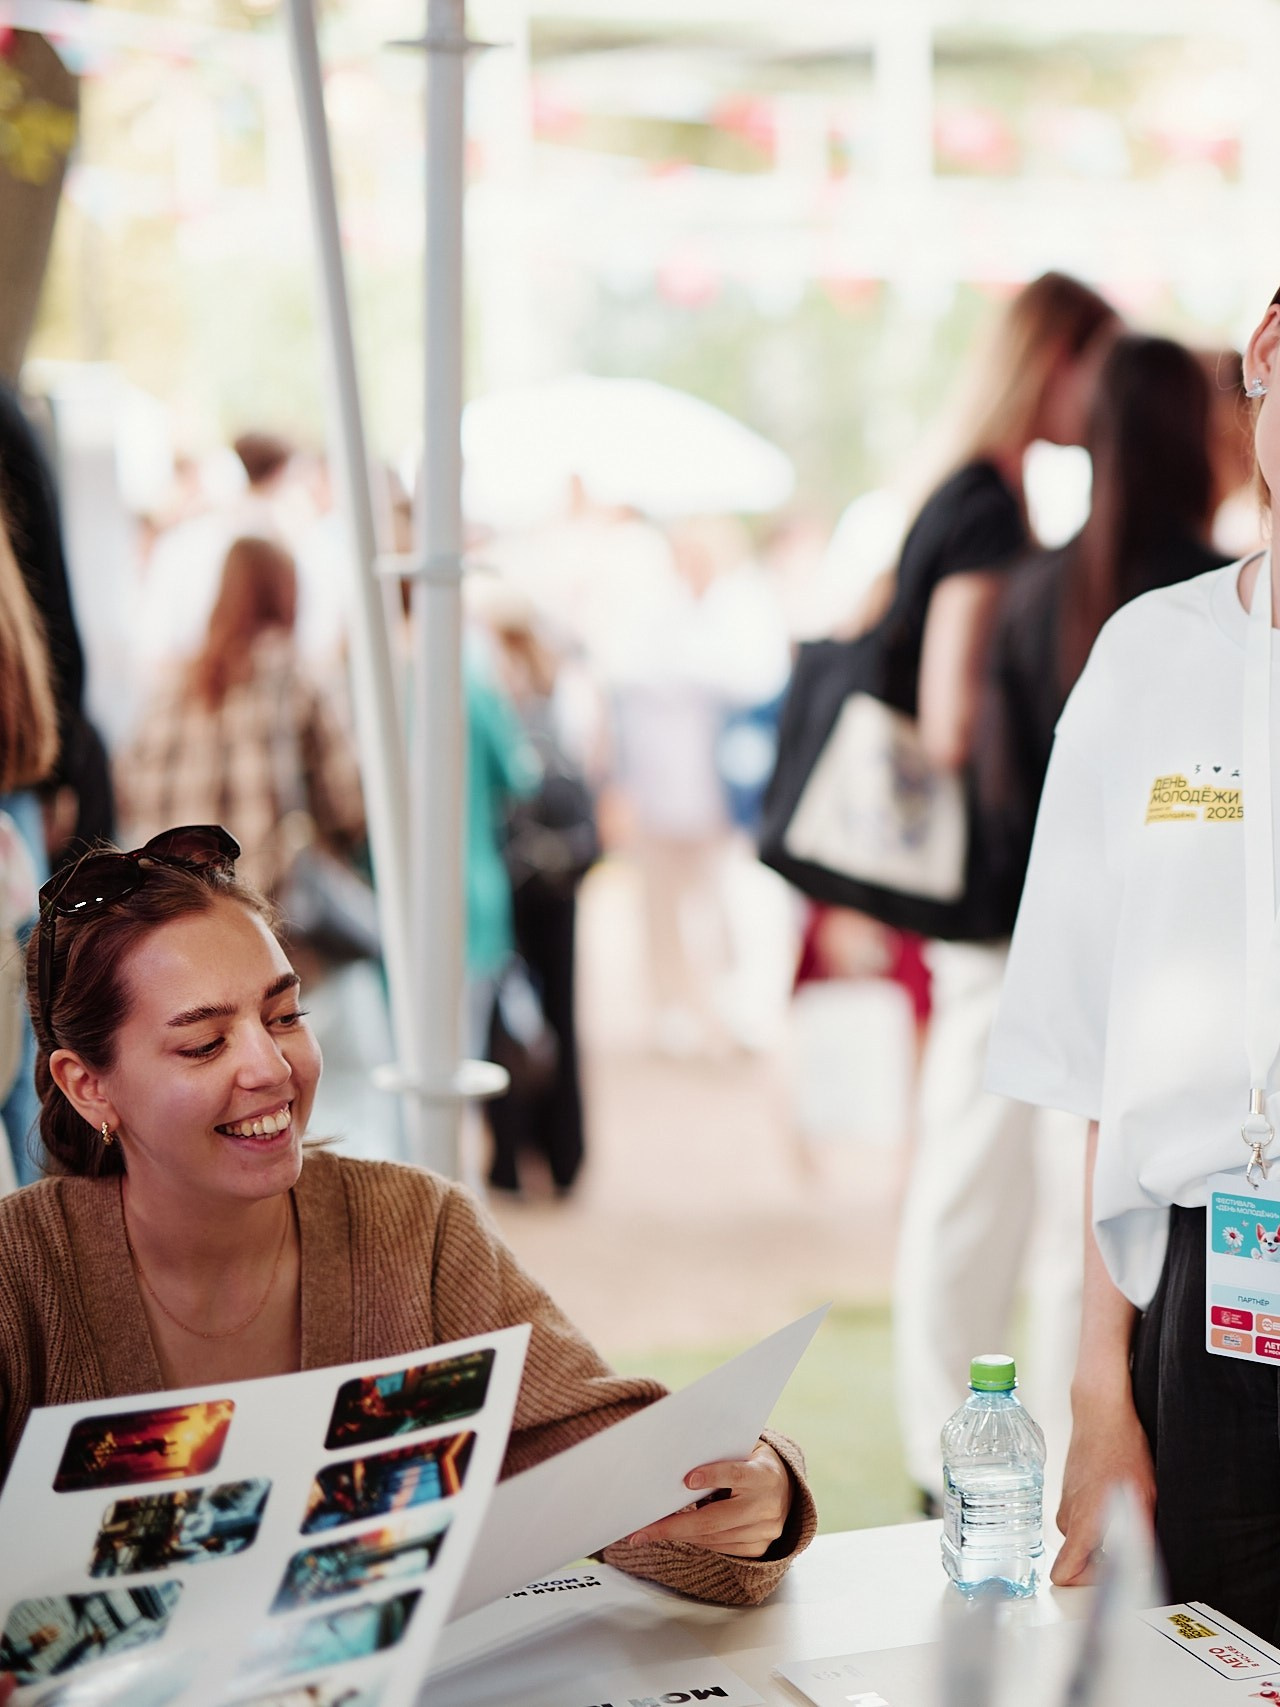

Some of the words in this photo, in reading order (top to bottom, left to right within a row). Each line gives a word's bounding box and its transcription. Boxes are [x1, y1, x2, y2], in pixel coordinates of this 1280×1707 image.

[1154, 777, 1187, 791] ДЕНЬ
[1151, 787, 1239, 804] МОЛОДЁЖИ
[1207, 806, 1244, 819] 2025
[1216, 1197, 1256, 1209] ФЕСТИВАЛЬ
[1209, 1648, 1248, 1668] ЛЕТО
